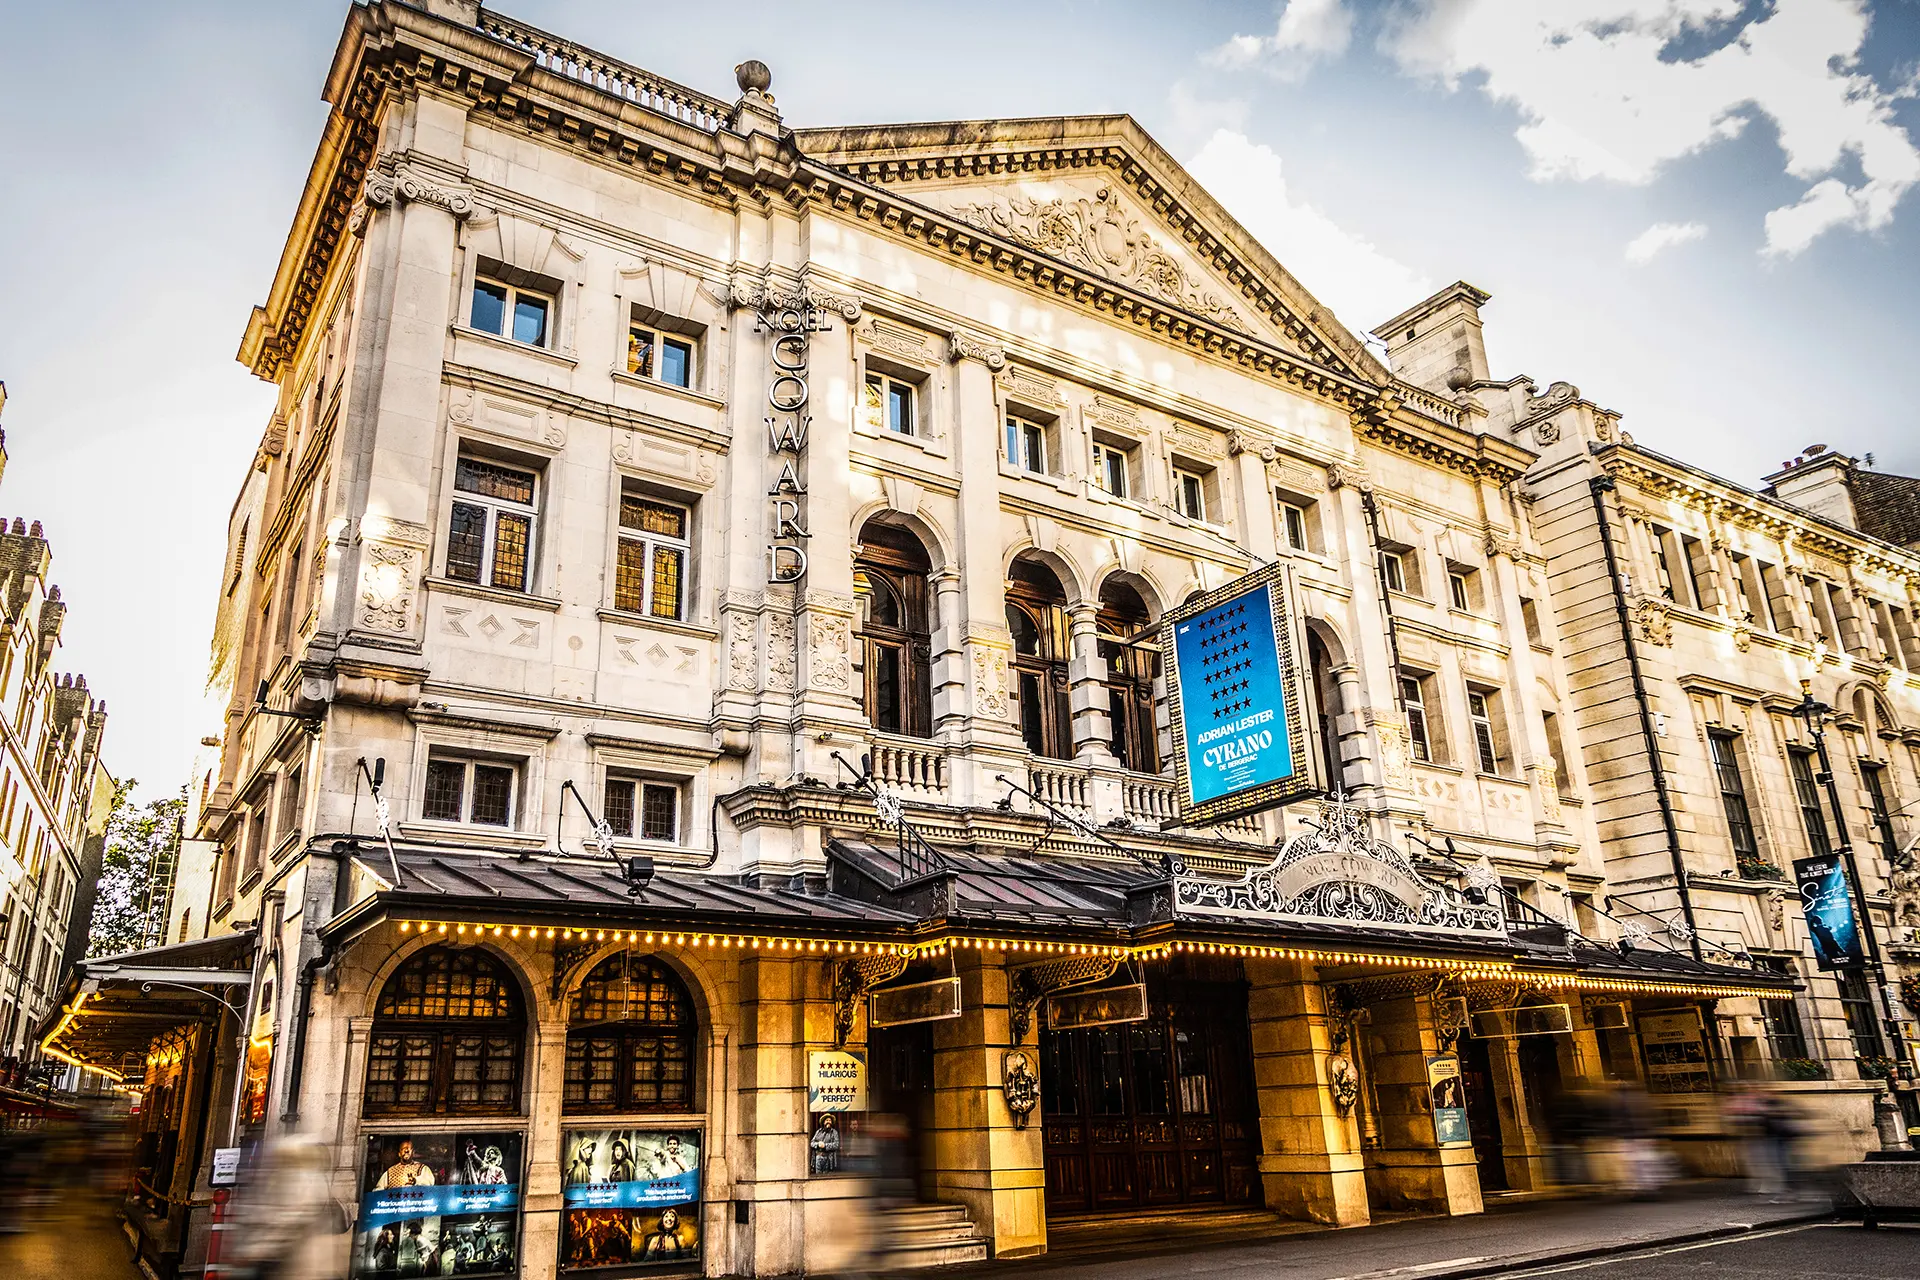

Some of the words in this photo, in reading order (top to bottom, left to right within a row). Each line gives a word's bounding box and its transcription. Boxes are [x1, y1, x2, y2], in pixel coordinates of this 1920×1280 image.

[753, 305, 832, 333] NOËL
[764, 335, 813, 584] COWARD
[1197, 722, 1236, 745] ADRIAN
[1236, 709, 1274, 730] LESTER
[1203, 730, 1272, 766] CYRANO
[1219, 763, 1227, 771] DE
[1228, 754, 1258, 769] BERGERAC
